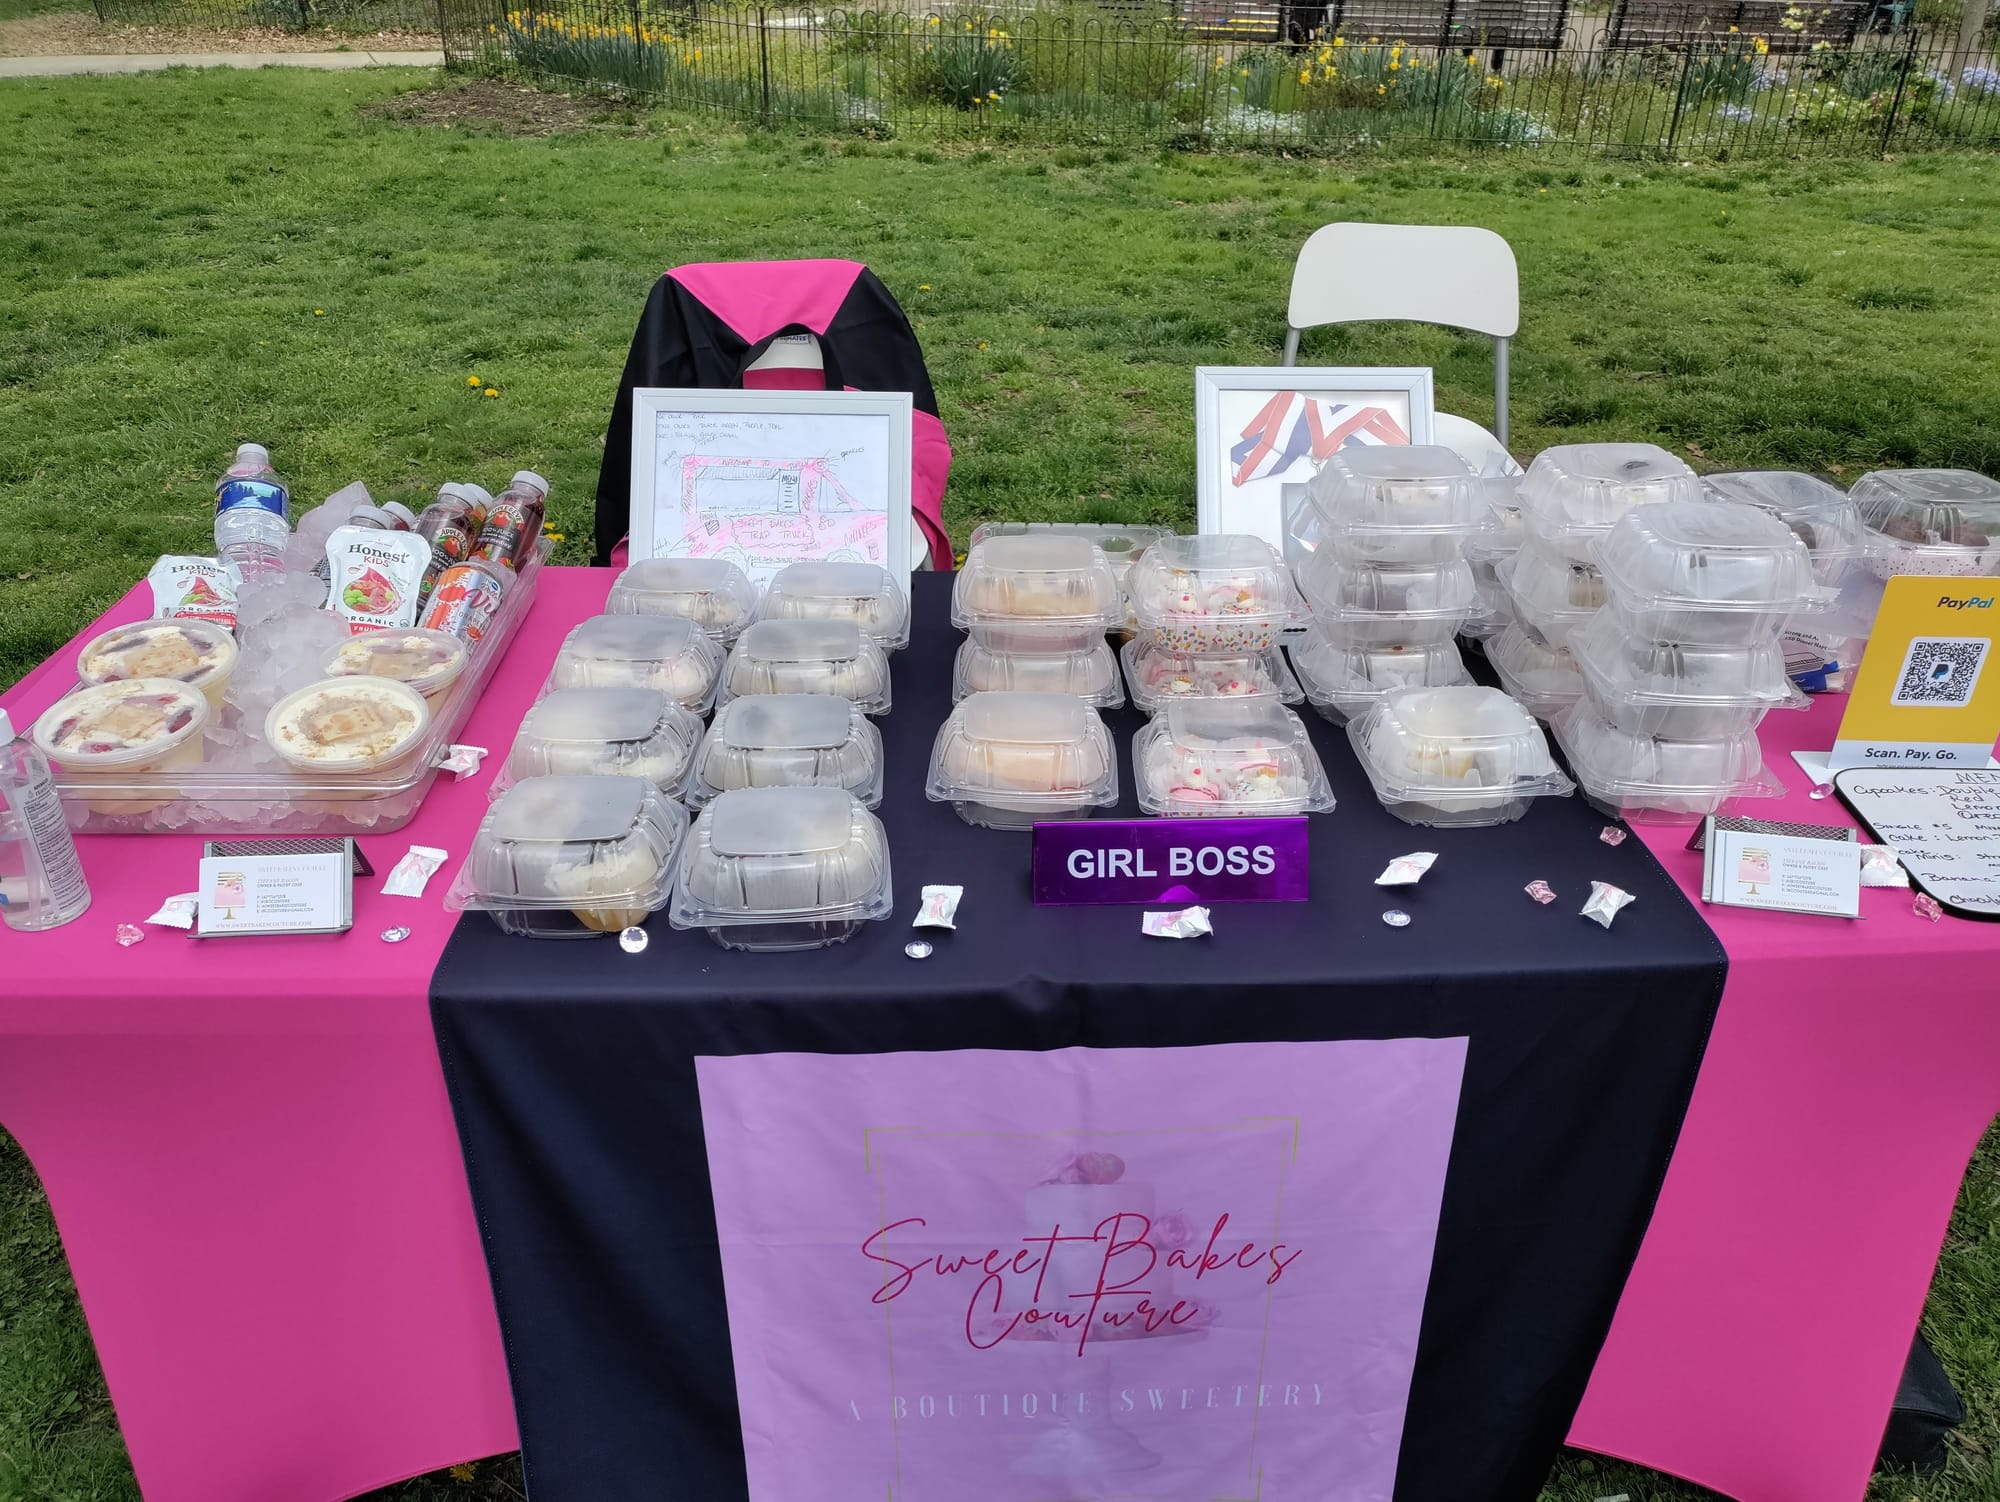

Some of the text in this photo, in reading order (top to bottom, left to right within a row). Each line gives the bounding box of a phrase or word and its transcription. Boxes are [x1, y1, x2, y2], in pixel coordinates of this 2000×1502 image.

[348, 543, 410, 564] Honest
[1937, 596, 1995, 611] PayPal
[1864, 747, 1957, 761] Scan. Pay. Go.
[1067, 845, 1276, 879] GIRL BOSS
[862, 1213, 1303, 1304] Sweet Bakes
[966, 1274, 1198, 1357] Couture
[893, 1392, 1093, 1420] BOUTIQUE
[1120, 1382, 1326, 1413] SWEETERY
